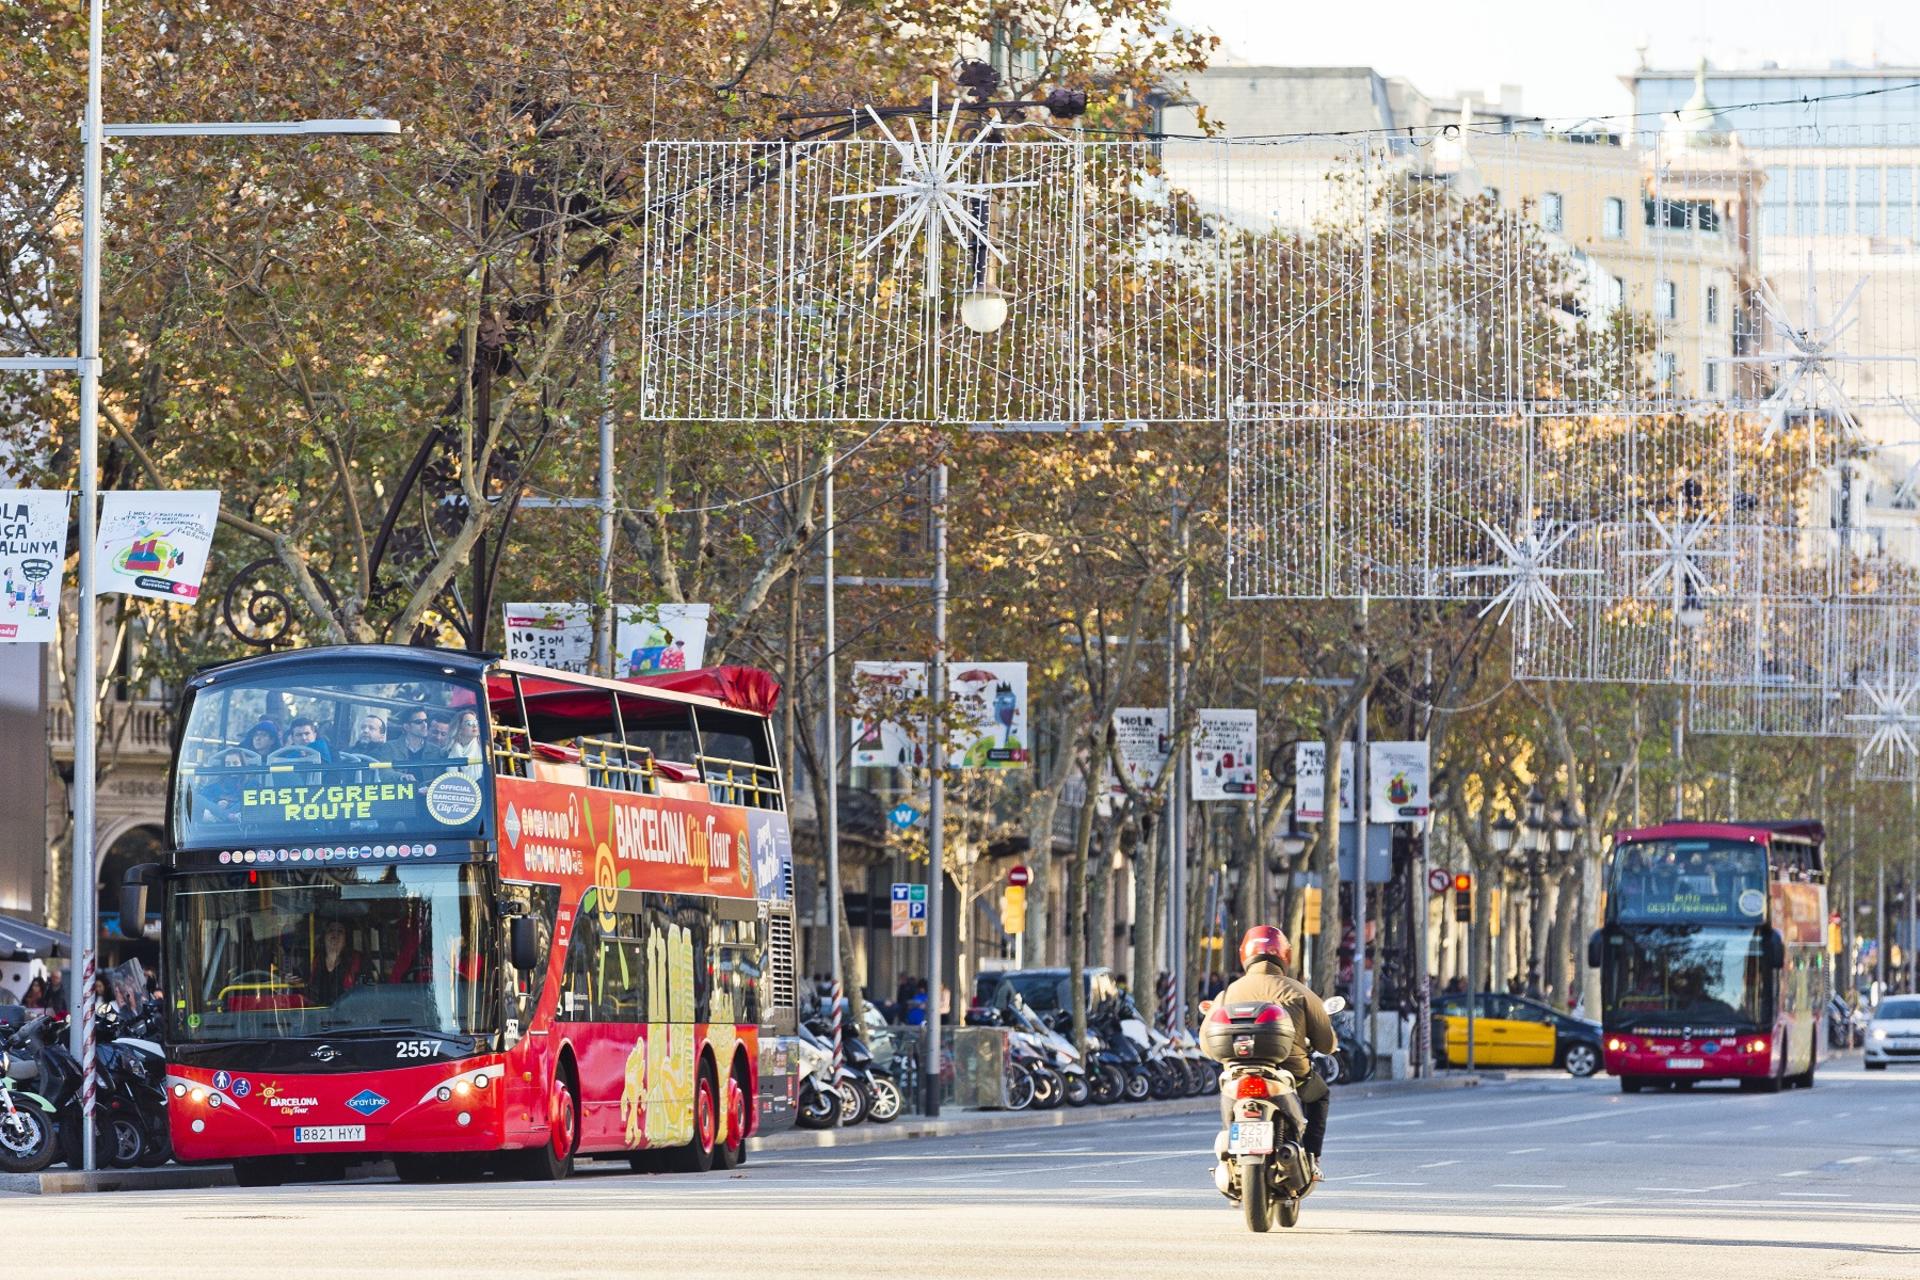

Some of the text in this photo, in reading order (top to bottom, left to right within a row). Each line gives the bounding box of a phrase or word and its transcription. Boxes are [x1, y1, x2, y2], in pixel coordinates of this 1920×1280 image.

[0, 503, 34, 526] LA,
[0, 524, 27, 539] ÇA
[243, 783, 414, 805] EAST/GREEN
[440, 784, 471, 792] OFFICIAL
[433, 794, 475, 802] BARCELONA
[284, 801, 371, 821] ROUTE
[614, 804, 689, 865] BARCELONA
[686, 813, 709, 883] City
[705, 815, 731, 868] Tour
[396, 1041, 442, 1058] 2557
[271, 1098, 318, 1107] BARCELONA
[303, 1128, 362, 1140] 8821 HYY
